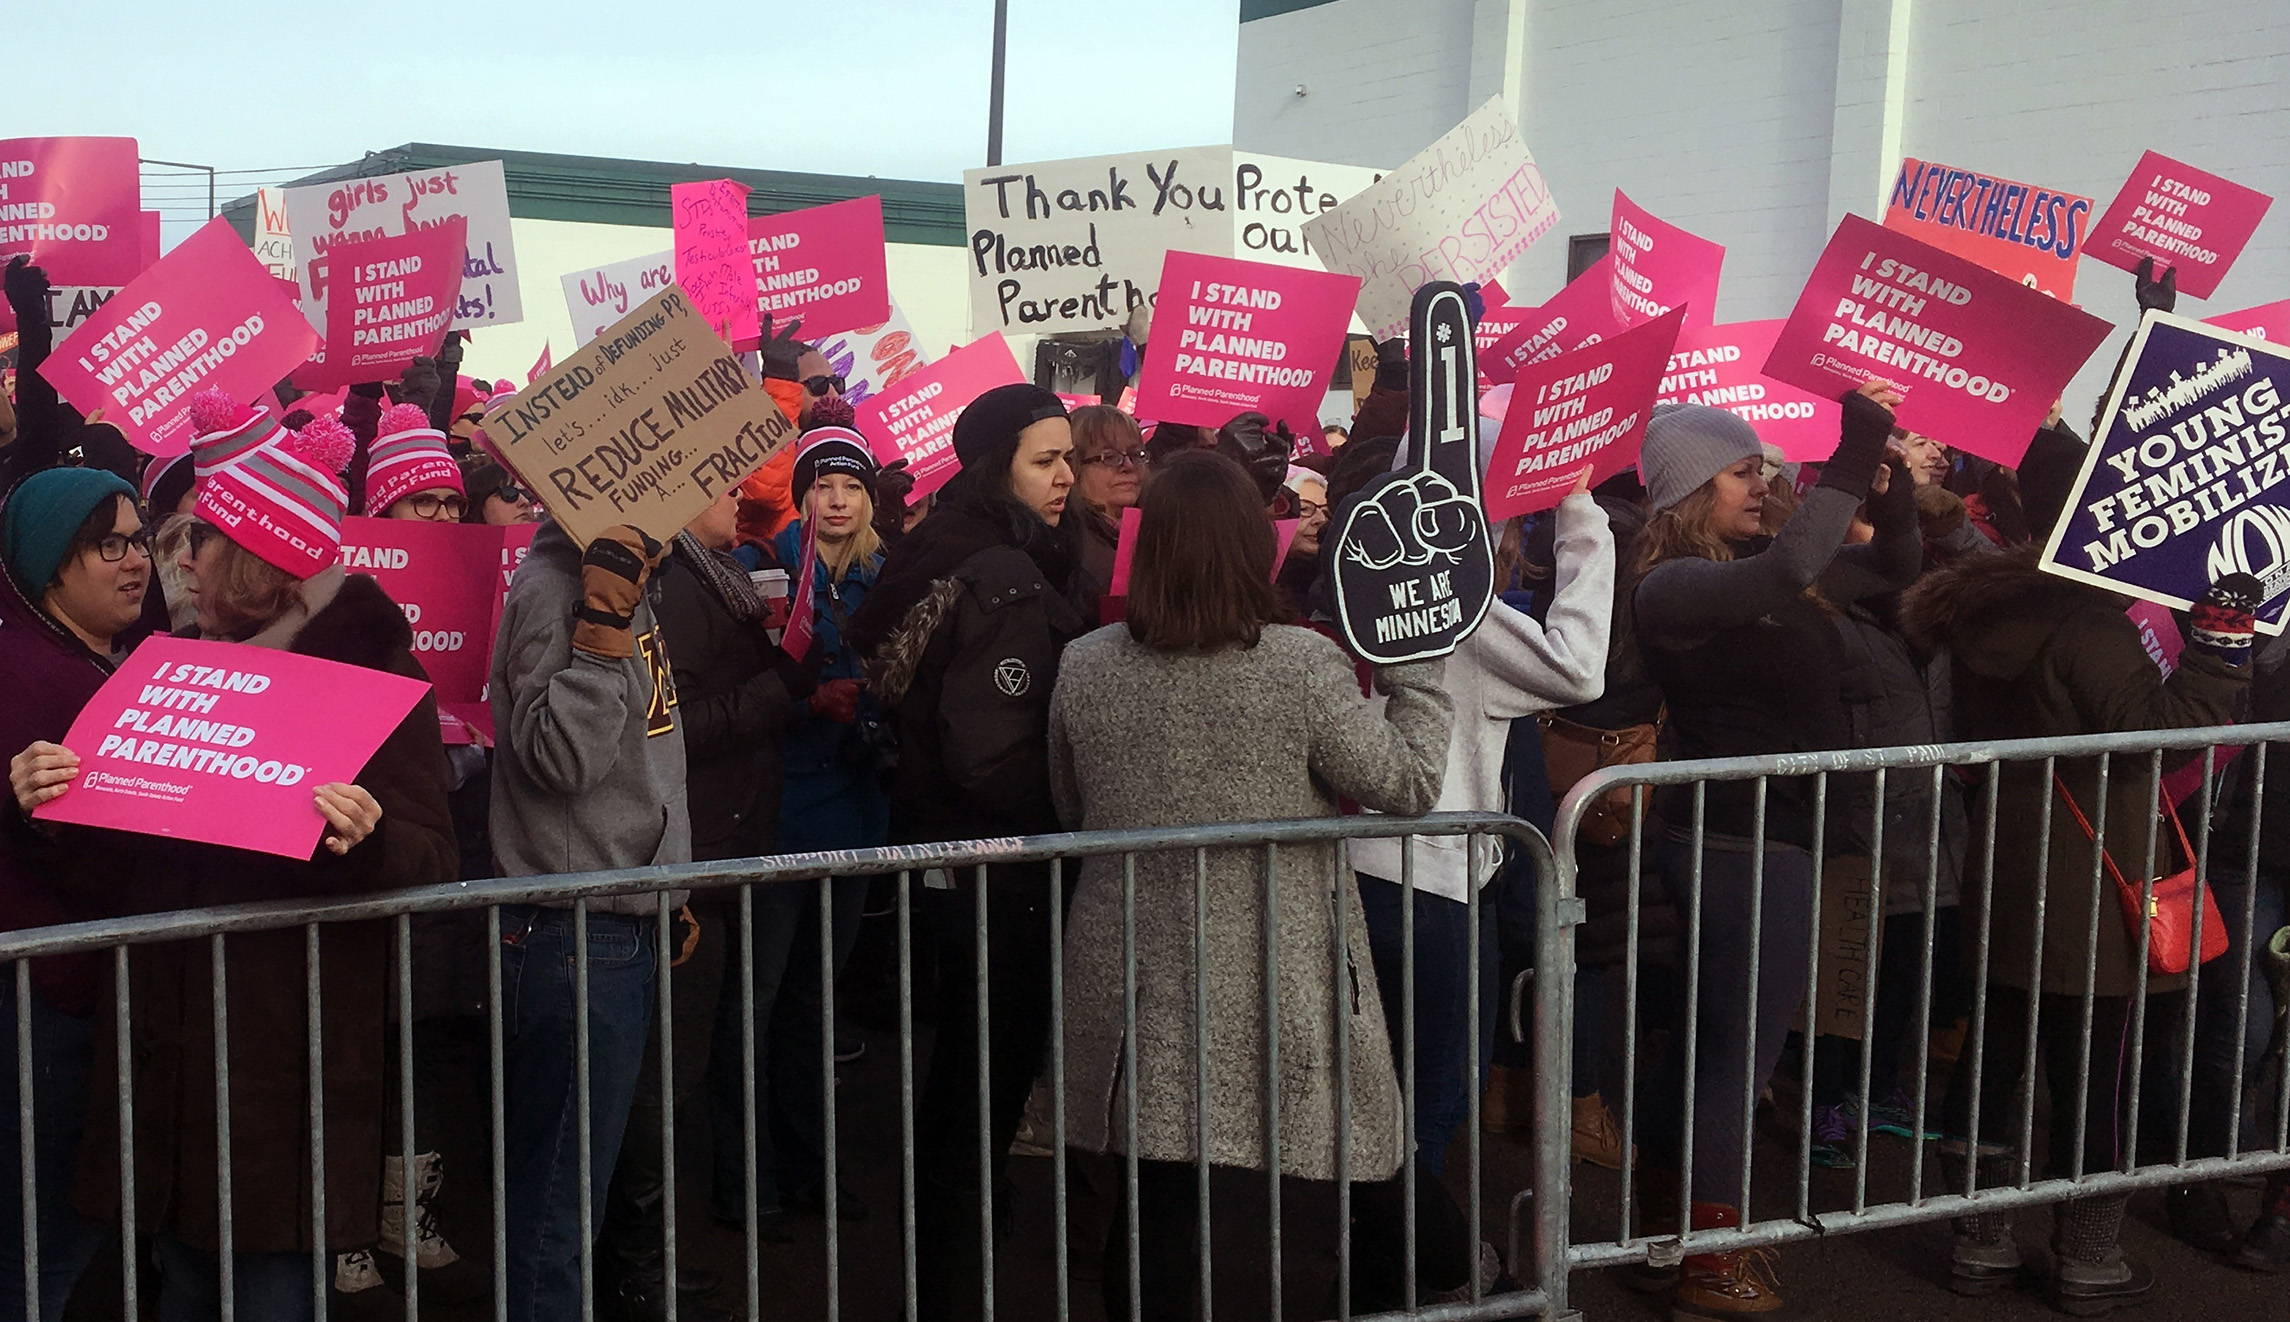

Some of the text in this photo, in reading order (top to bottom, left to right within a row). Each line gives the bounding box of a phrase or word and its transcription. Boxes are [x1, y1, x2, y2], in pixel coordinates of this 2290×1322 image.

[328, 179, 388, 229] girls
[403, 171, 459, 211] just
[980, 160, 1227, 221] Thank You
[1236, 163, 1340, 216] Prote
[1320, 119, 1517, 264] Nevertheless
[2144, 191, 2186, 216] WITH
[2151, 174, 2211, 207] I STAND
[1398, 163, 1549, 296] PERSISTED
[1892, 163, 2088, 259] NEVERTHELESS
[2132, 205, 2203, 241] PLANNED
[747, 232, 800, 257] TAND
[972, 221, 1103, 278] Planned
[1617, 235, 1637, 264] WITH
[1623, 221, 1654, 252] STAND
[2121, 220, 2218, 265] PARENTHOOD
[354, 267, 361, 283] I
[365, 255, 422, 282] STAND
[752, 254, 780, 273] TH
[757, 268, 820, 292] ANNED
[1614, 255, 1653, 294] PLANNED
[1859, 251, 1971, 306] I STAND
[355, 281, 404, 304] WITH
[580, 270, 628, 313] Why
[640, 264, 671, 290] are
[1191, 281, 1282, 310] I STAND
[1851, 274, 1928, 318] WITH
[353, 307, 451, 346] PARENTHOOD
[354, 295, 434, 326] PLANNED
[1188, 305, 1253, 332] WITH
[1835, 298, 1963, 358] PLANNED
[78, 301, 163, 373] I STAND
[361, 346, 424, 361] Planned Parenthood
[648, 337, 687, 372] just
[1179, 329, 1286, 361] PLANNED
[1504, 355, 1515, 369] I
[1513, 316, 1568, 362] STAND
[95, 336, 158, 387] WITH
[112, 328, 209, 407] PLANNED
[128, 315, 265, 427] PARENTHOOD
[1174, 353, 1313, 388] PARENTHOOD
[1352, 350, 1379, 372] Kee
[1664, 344, 1740, 373] STAND
[1822, 323, 2010, 404] PARENTHOOD
[1826, 356, 1862, 376] Planned
[494, 365, 595, 446] INSTEAD
[599, 313, 666, 366] DEFUNDING
[1182, 384, 1214, 397] Planned
[1214, 388, 1260, 403] Parenthood
[1537, 362, 1613, 405] I STAND
[878, 381, 943, 424] I STAND
[1533, 395, 1586, 428] WITH
[549, 407, 675, 511] REDUCE
[662, 354, 750, 429] MILITARY
[887, 408, 935, 437] WITH
[1523, 407, 1613, 453] PLANNED
[2107, 376, 2281, 484] YOUNG
[690, 409, 794, 499] FRACTION
[1515, 414, 1637, 476] PARENTHOOD
[409, 468, 452, 486] Fund
[1518, 478, 1548, 491] Planned
[201, 490, 242, 529] Fund
[206, 474, 324, 560] arenthood
[335, 546, 409, 570] TAND
[1388, 570, 1454, 609] WE ARE
[152, 661, 271, 695] I STAND
[137, 684, 221, 714] WITH
[114, 708, 256, 748] PLANNED
[97, 735, 305, 787] PARENTHOOD
[98, 772, 190, 796] Planned Parenthood
[1833, 877, 1872, 1020] HEALTH CARE
